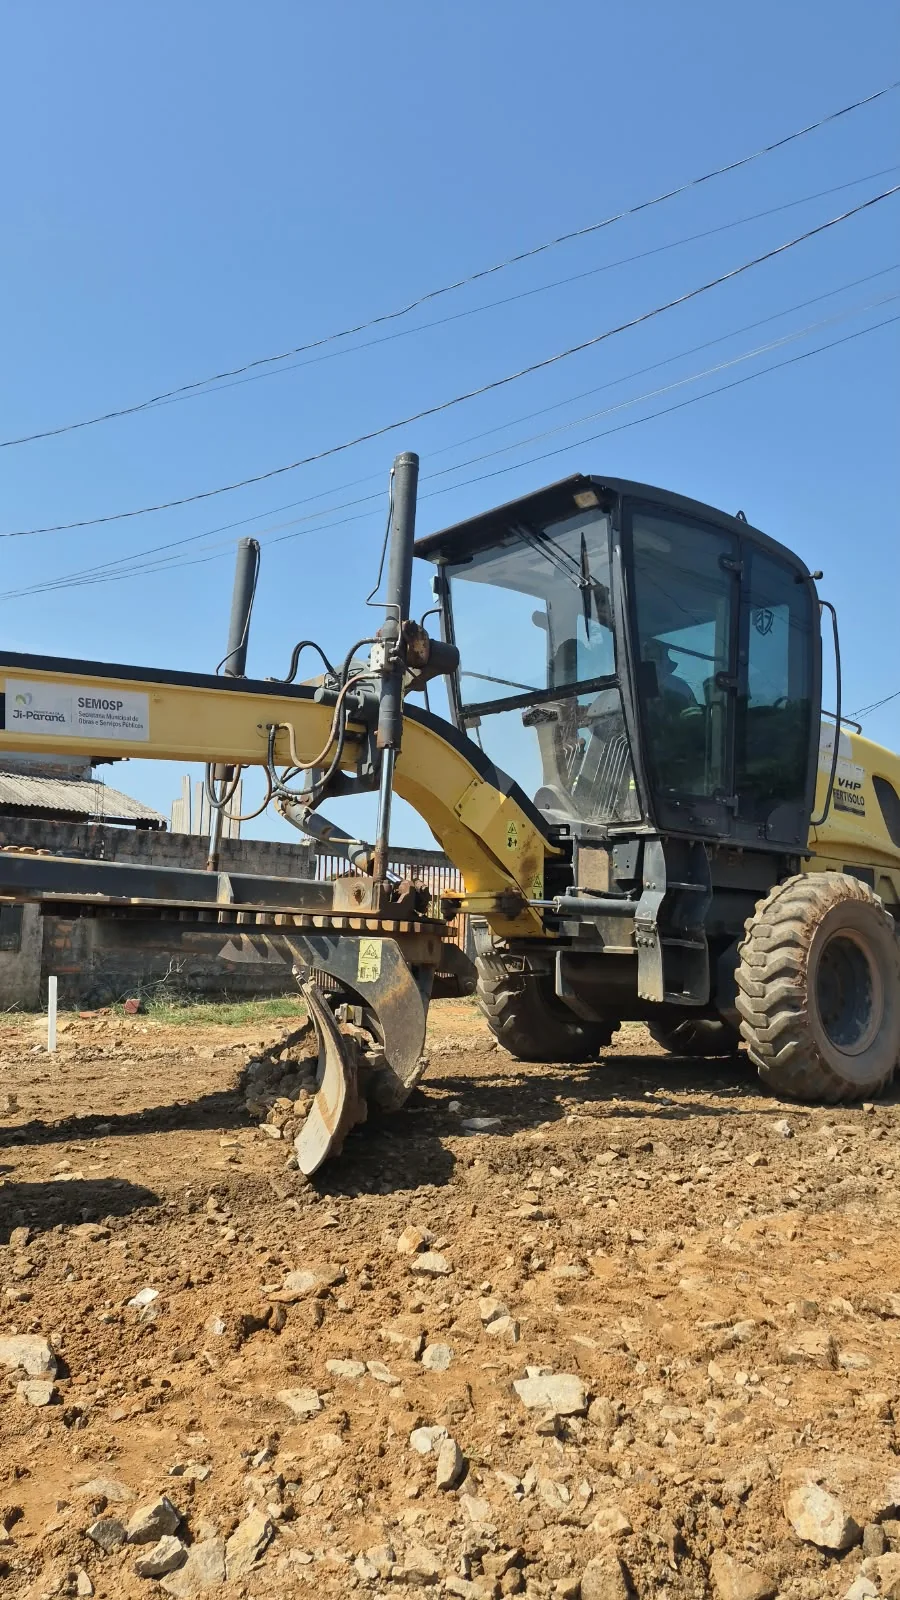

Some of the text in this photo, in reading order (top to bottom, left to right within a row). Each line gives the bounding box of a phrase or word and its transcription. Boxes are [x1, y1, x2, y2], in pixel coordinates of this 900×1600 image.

[78, 697, 123, 711] SEMOSP
[13, 709, 66, 722] Ji-Paraná
[106, 713, 132, 721] Municipal
[99, 720, 122, 728] Serviços
[122, 721, 144, 729] Públicos
[838, 777, 861, 790] VHP
